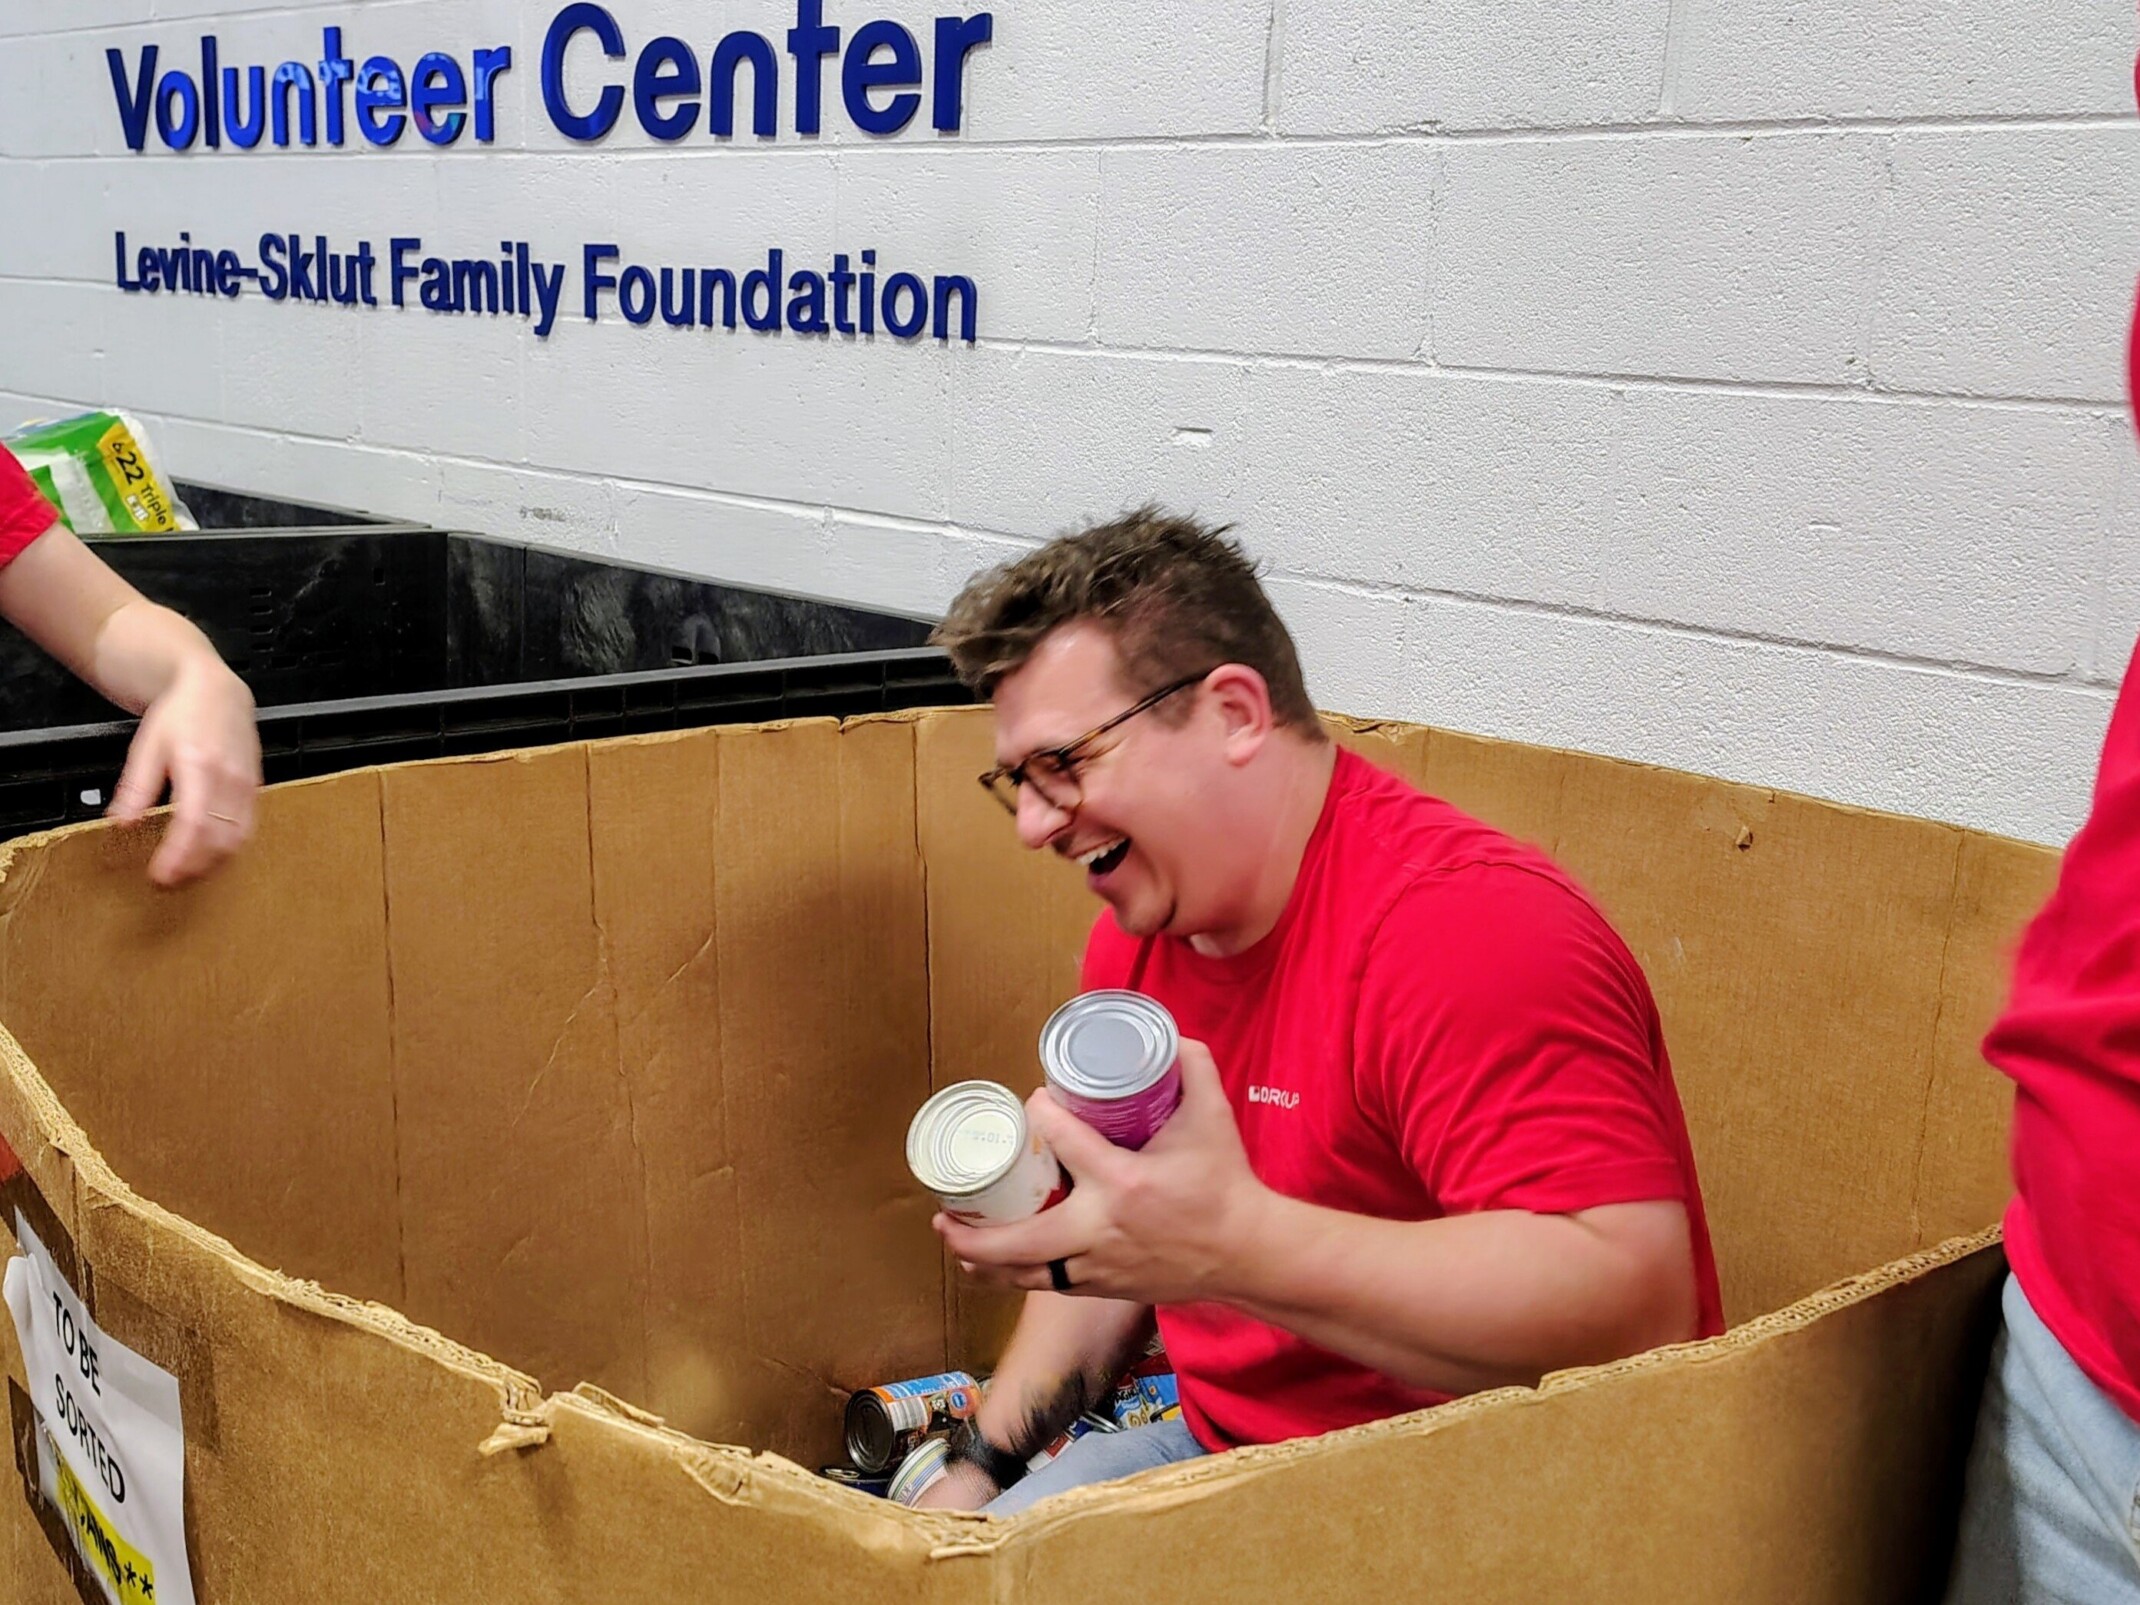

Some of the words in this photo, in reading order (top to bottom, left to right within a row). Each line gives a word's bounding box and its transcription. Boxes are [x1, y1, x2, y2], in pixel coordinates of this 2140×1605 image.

[105, 26, 512, 151] Volunteer
[540, 0, 993, 141] Center
[115, 231, 378, 307] Levine-Sklut
[390, 237, 564, 337] Family
[583, 244, 978, 343] Foundation
[115, 451, 145, 486] 22
[140, 484, 167, 526] Triple
[53, 1291, 76, 1356] TO
[79, 1327, 102, 1397] BE
[55, 1373, 126, 1504] SORTED
